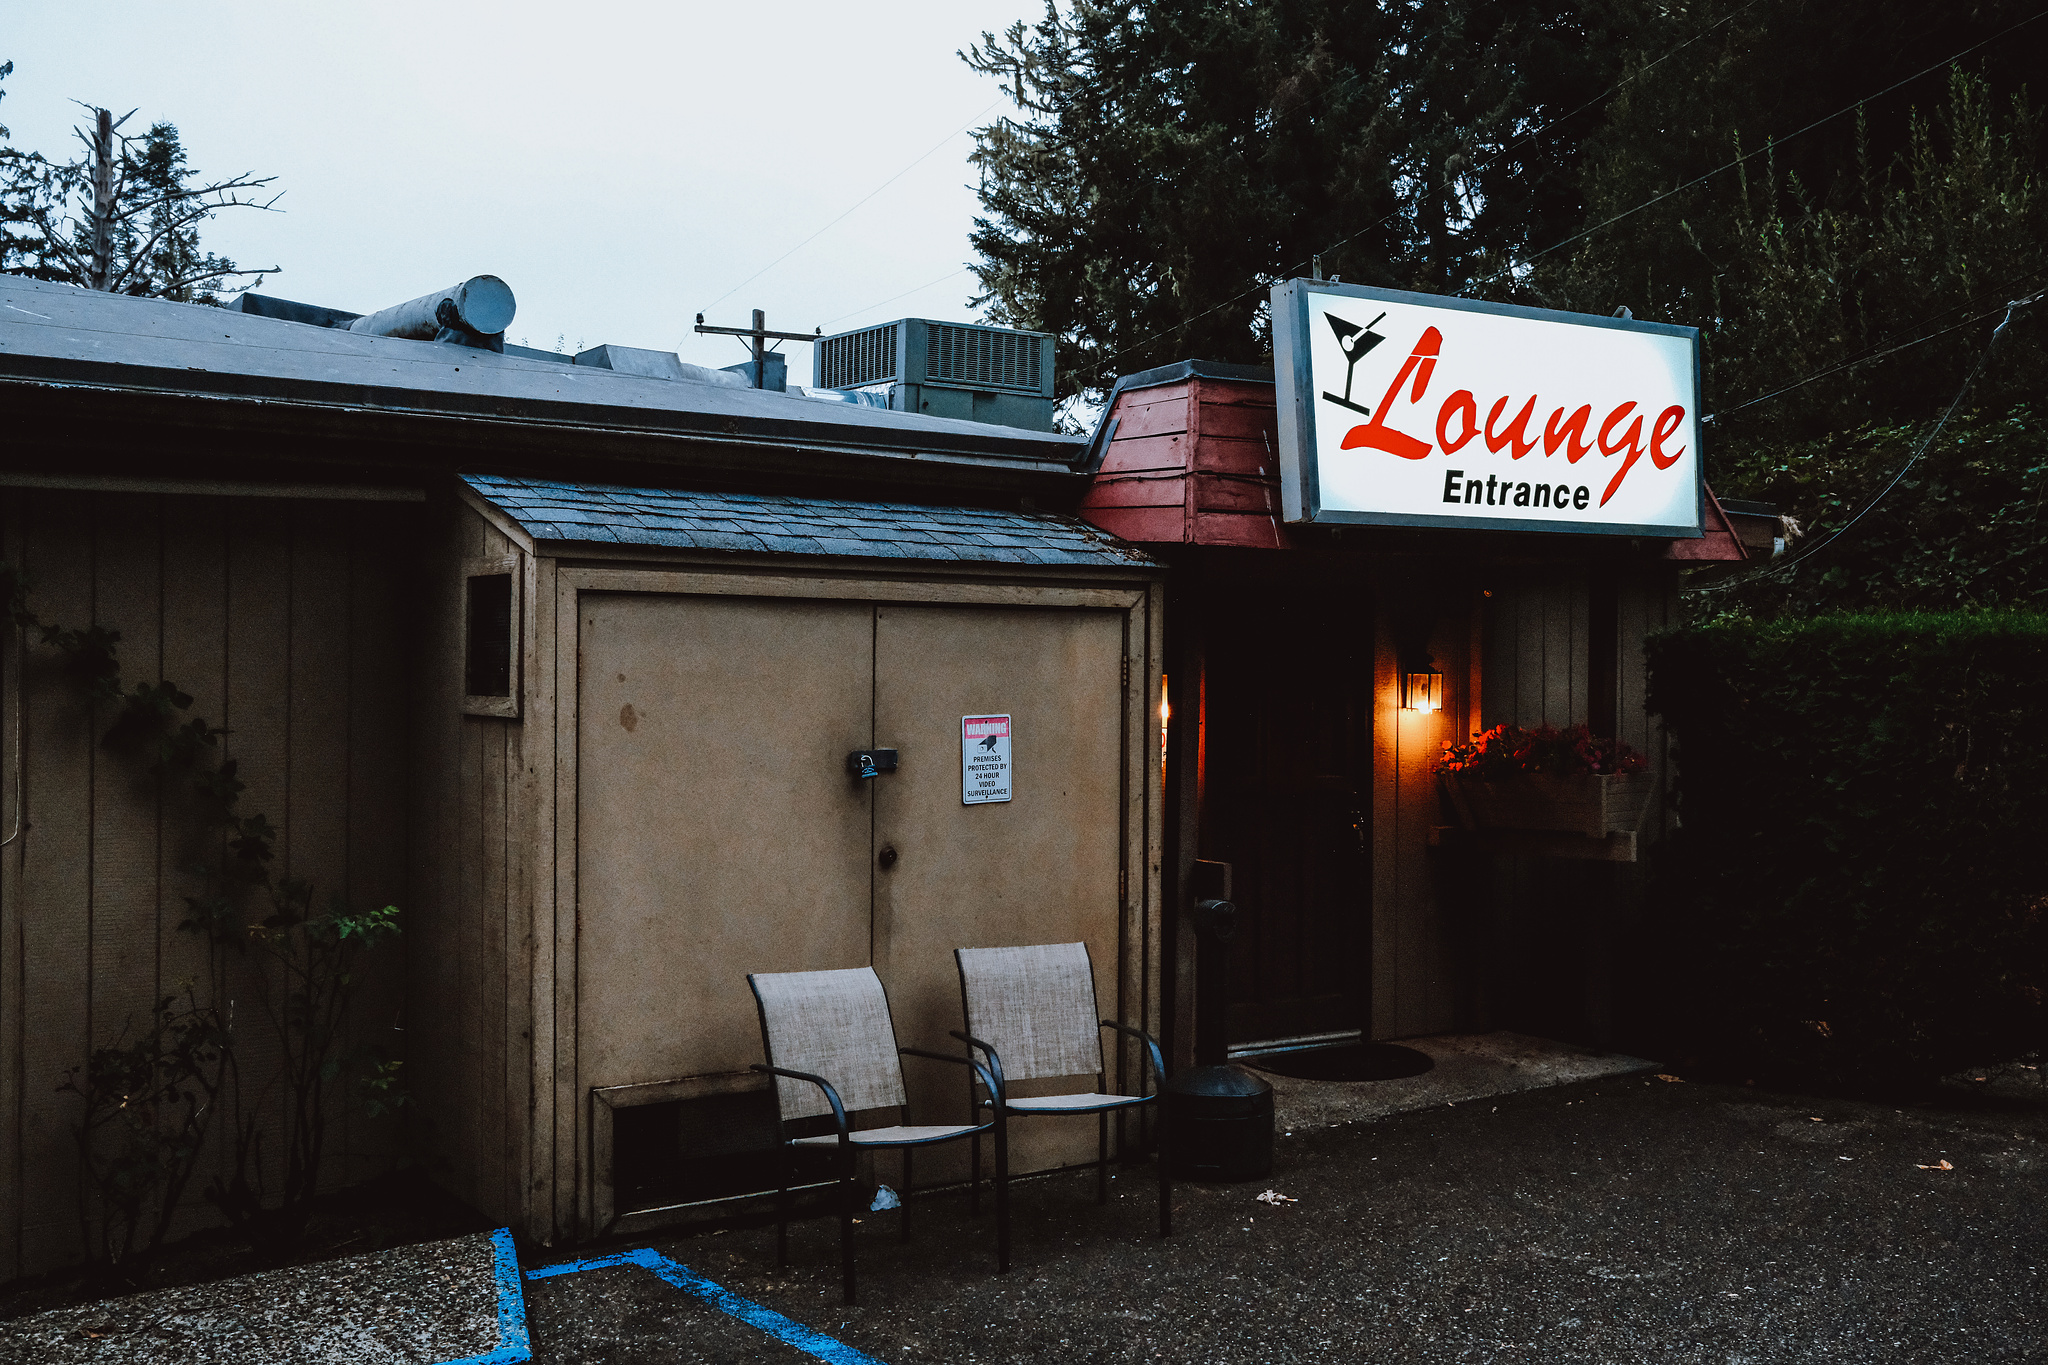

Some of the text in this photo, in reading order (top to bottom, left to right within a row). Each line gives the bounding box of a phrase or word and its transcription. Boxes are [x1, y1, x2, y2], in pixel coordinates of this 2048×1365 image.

[1340, 326, 1687, 509] Lounge
[1442, 470, 1590, 510] Entrance
[966, 723, 1007, 735] WARNING
[973, 755, 1002, 763] PREMISES
[978, 780, 996, 788] VIDEO
[967, 788, 1008, 797] SURVEILLANCE
